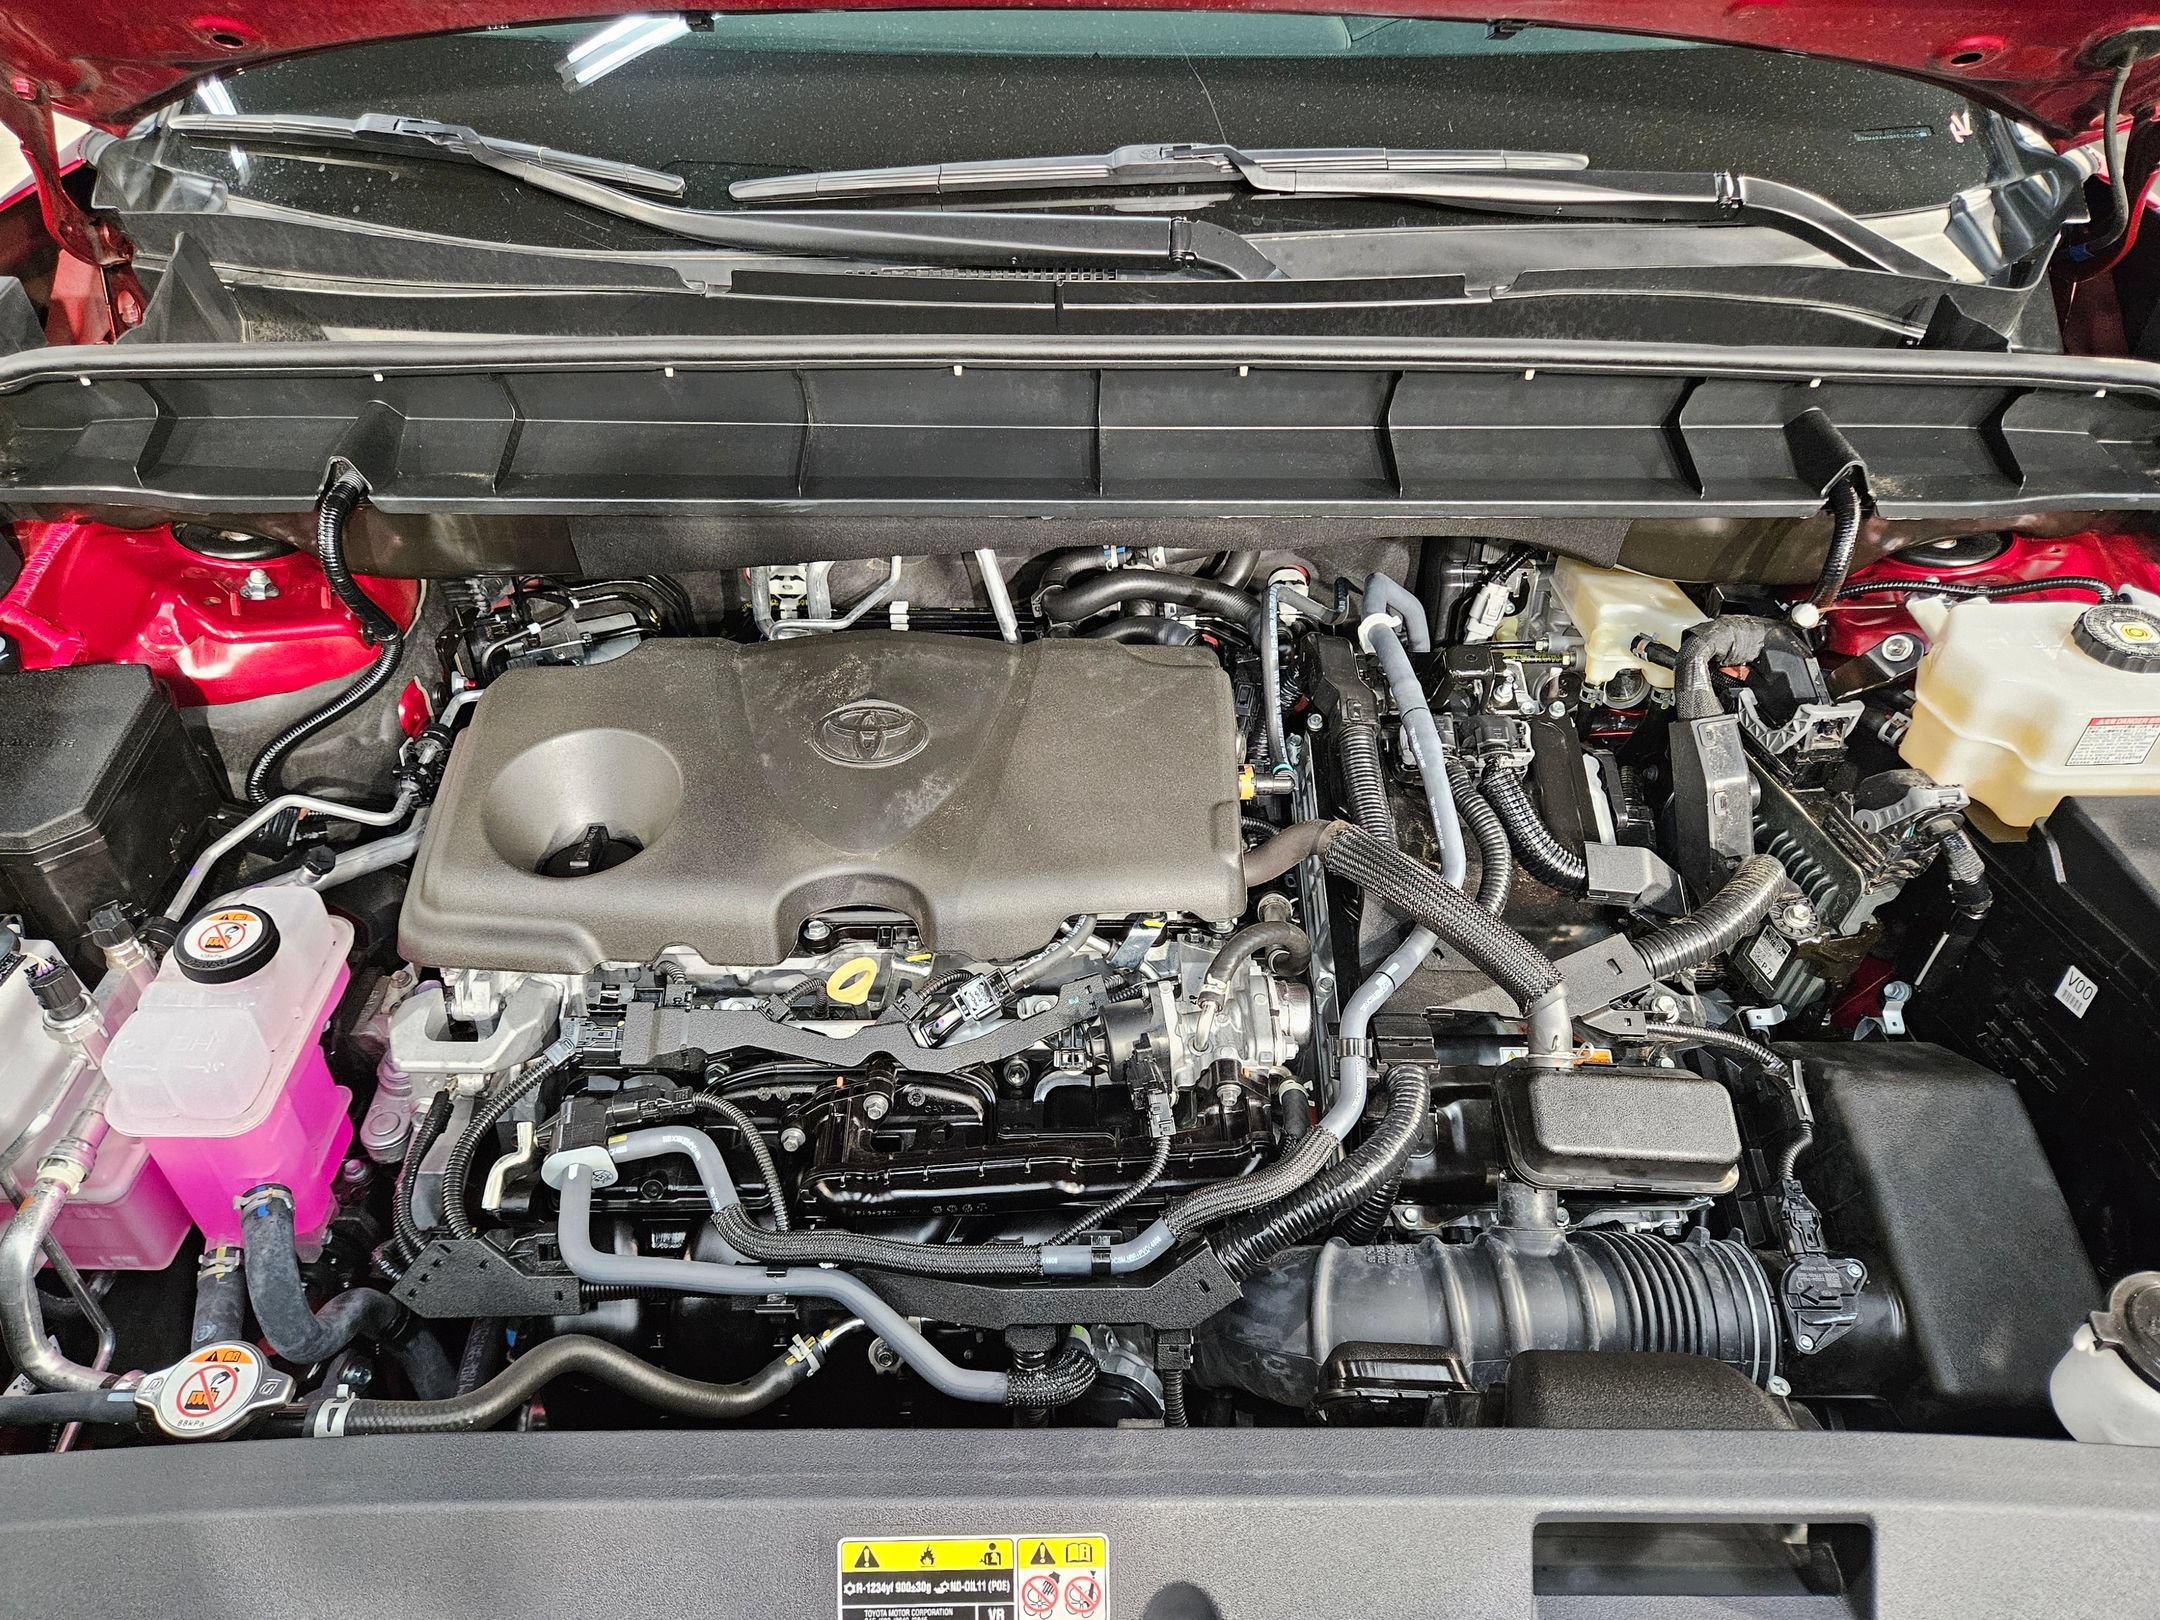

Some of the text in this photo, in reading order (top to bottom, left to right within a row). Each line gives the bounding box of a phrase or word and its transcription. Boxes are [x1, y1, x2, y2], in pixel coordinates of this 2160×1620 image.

[987, 1579, 1011, 1593] (POE)
[864, 1608, 954, 1617] TOYOTA MOTOR CORPORATION
